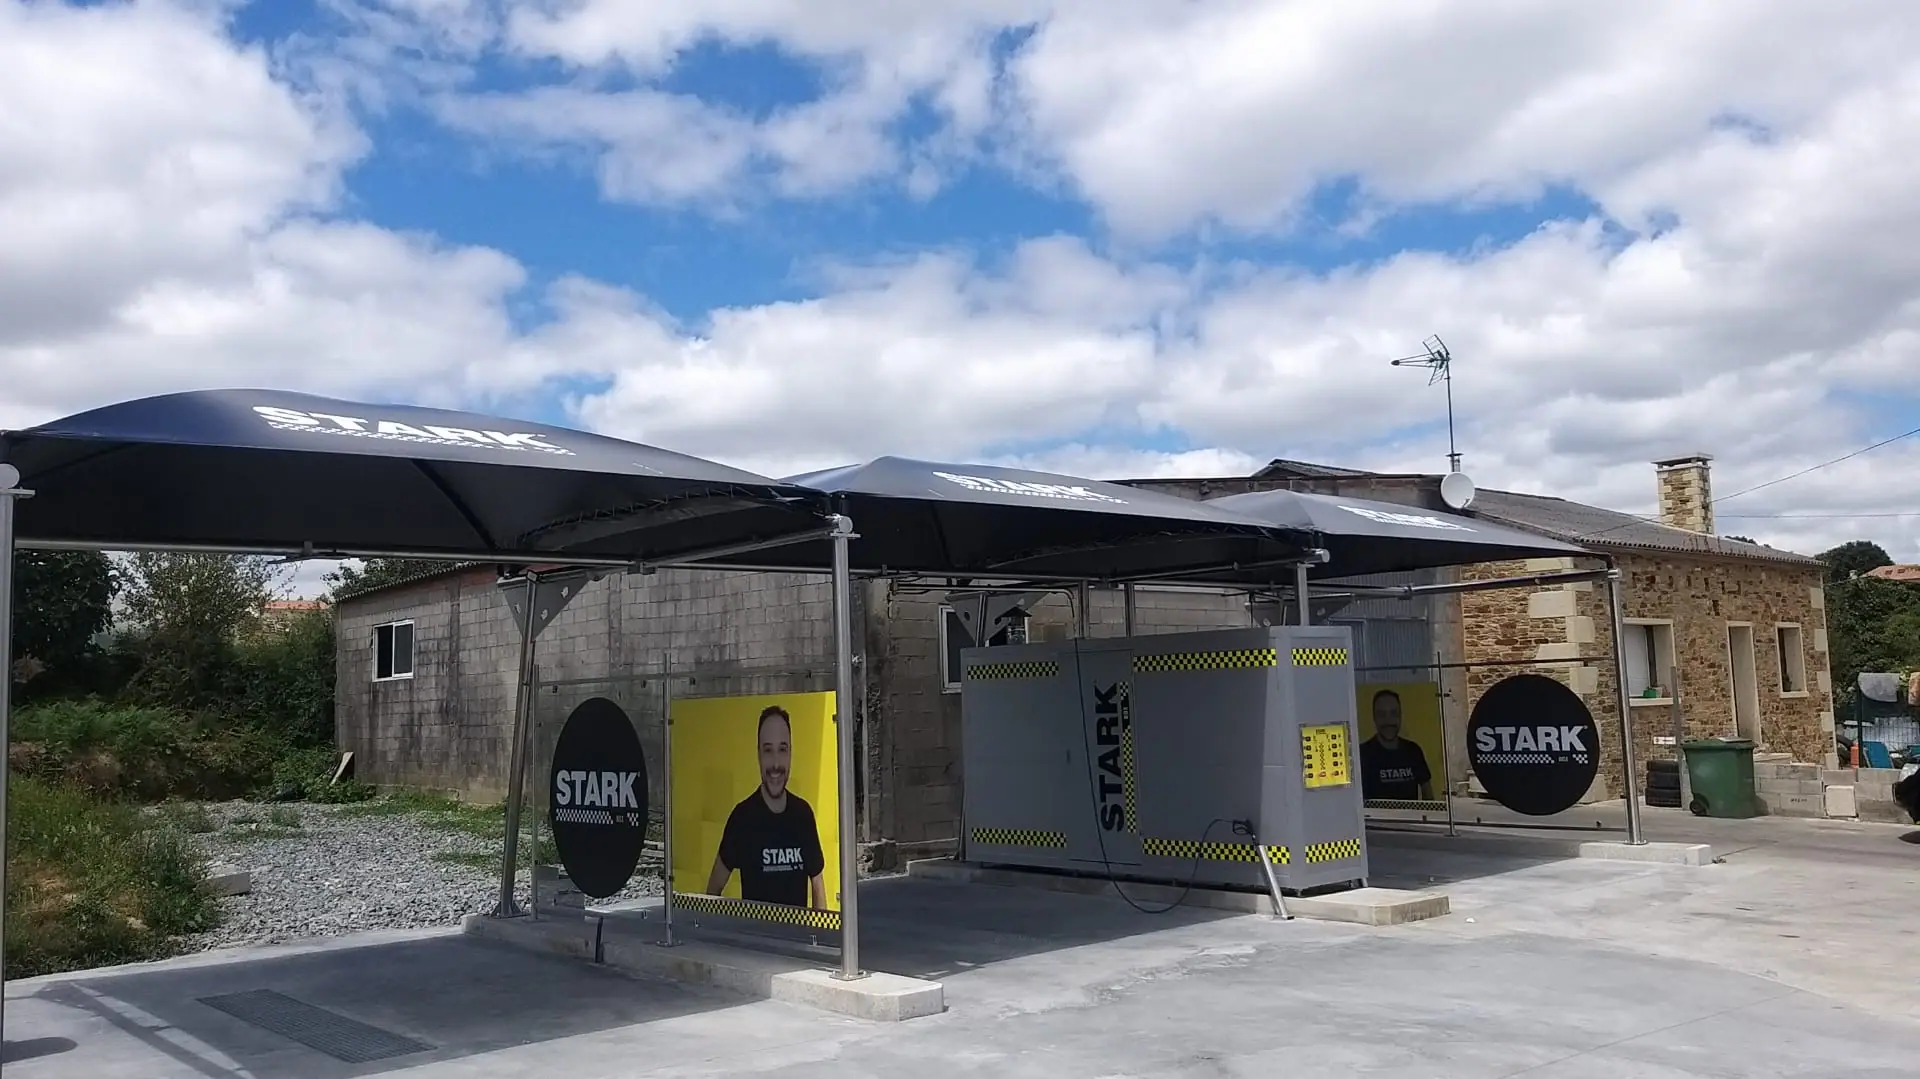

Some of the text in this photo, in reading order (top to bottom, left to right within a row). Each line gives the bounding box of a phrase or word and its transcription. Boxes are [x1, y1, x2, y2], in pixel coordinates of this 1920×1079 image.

[252, 406, 564, 449] STARK
[1475, 725, 1587, 752] STARK
[1094, 682, 1125, 832] STARK
[1380, 767, 1413, 778] STARK
[556, 769, 639, 808] STARK
[762, 847, 803, 864] STARK
